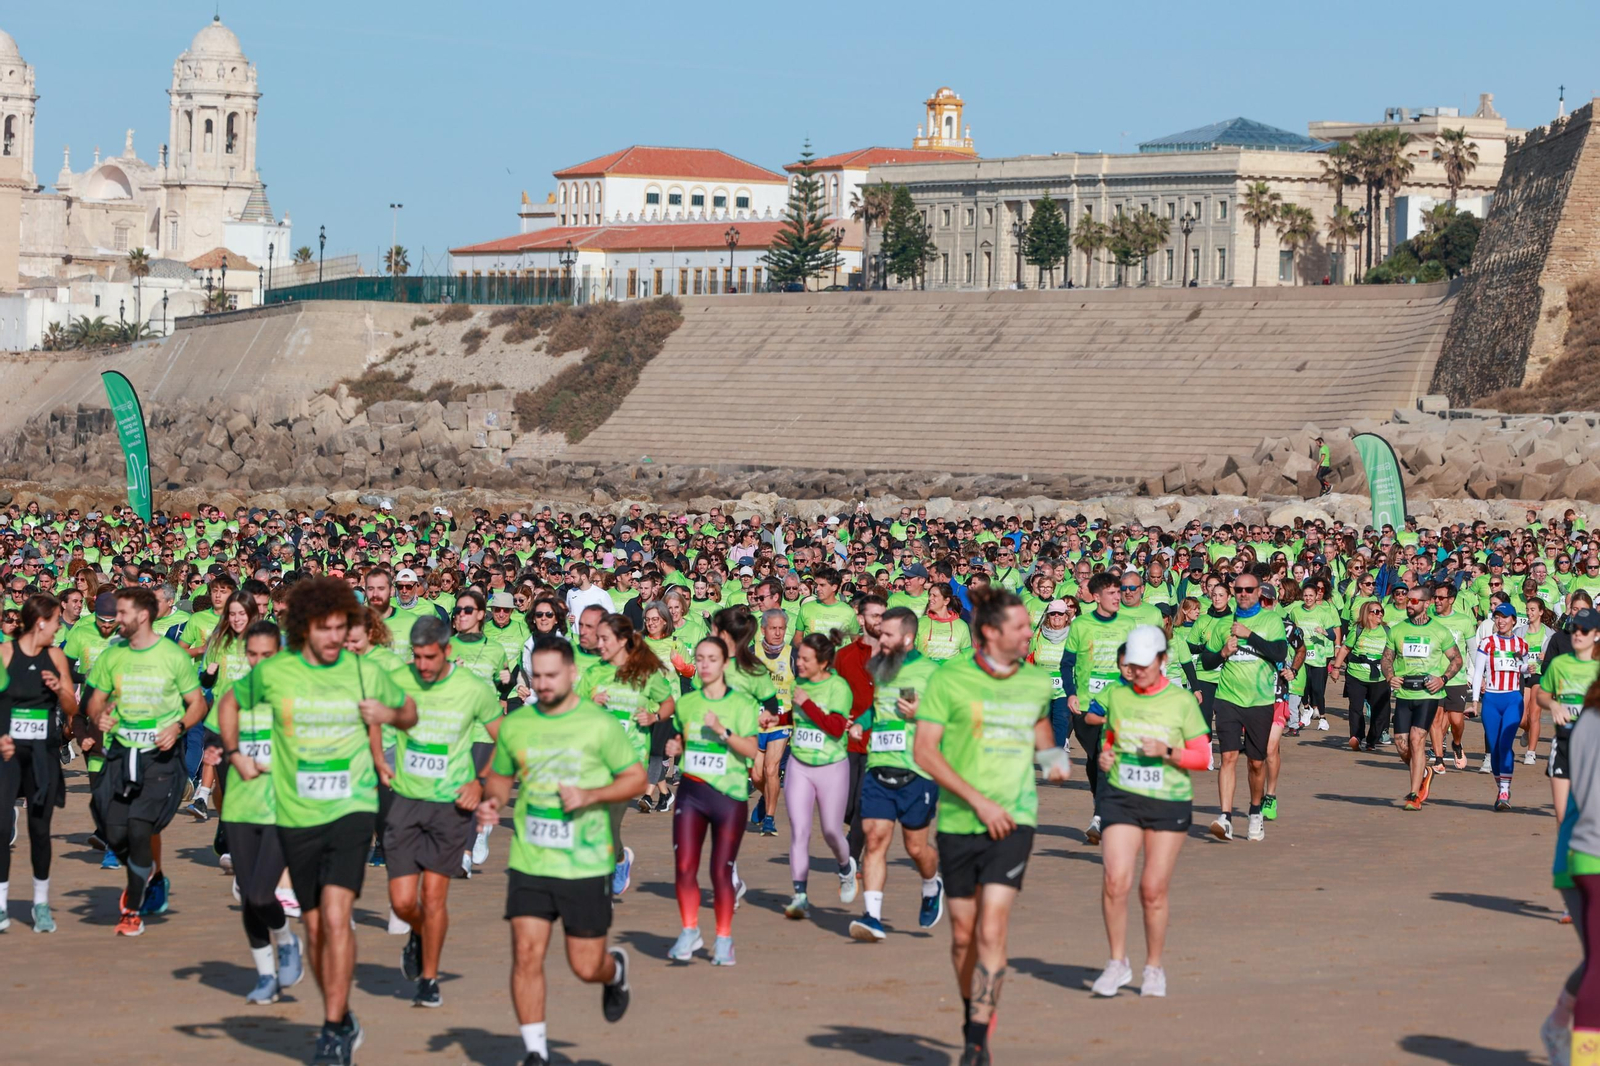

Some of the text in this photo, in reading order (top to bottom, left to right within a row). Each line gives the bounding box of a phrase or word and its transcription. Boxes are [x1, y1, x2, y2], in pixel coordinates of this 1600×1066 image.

[1095, 681, 1106, 689] 21
[15, 721, 45, 733] 2794
[126, 731, 156, 743] 1778
[797, 730, 822, 743] 5016
[878, 733, 903, 745] 1676
[246, 743, 271, 757] 270
[410, 755, 445, 770] 2703
[693, 754, 724, 768] 1475
[308, 774, 348, 790] 2778
[1127, 768, 1160, 782] 2138
[531, 821, 569, 839] 2783
